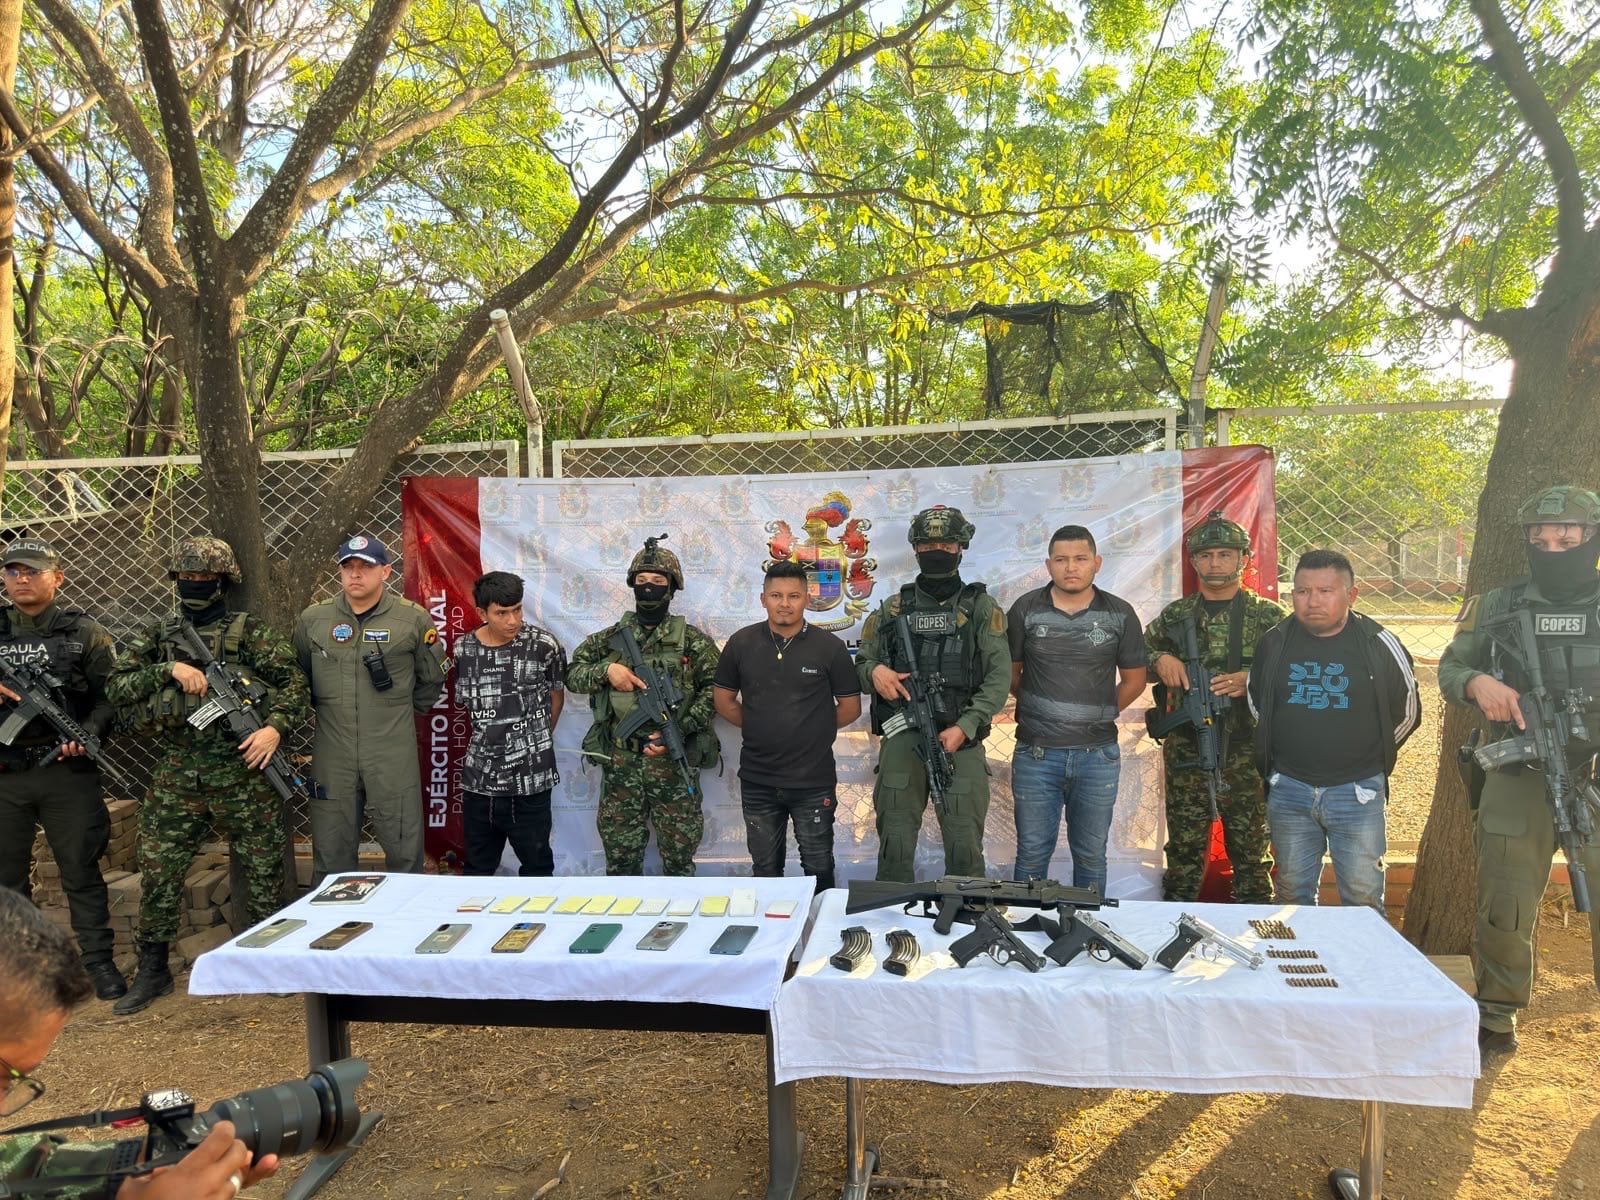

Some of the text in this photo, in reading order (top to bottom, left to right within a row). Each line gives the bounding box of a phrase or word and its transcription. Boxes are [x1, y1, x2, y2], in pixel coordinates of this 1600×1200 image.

[918, 616, 944, 629] COPES
[1540, 618, 1580, 632] COPES
[0, 643, 47, 655] GAULA
[3, 652, 49, 665] OLICA
[482, 666, 507, 674] CHANEL
[426, 714, 449, 828] EJÉRCITO
